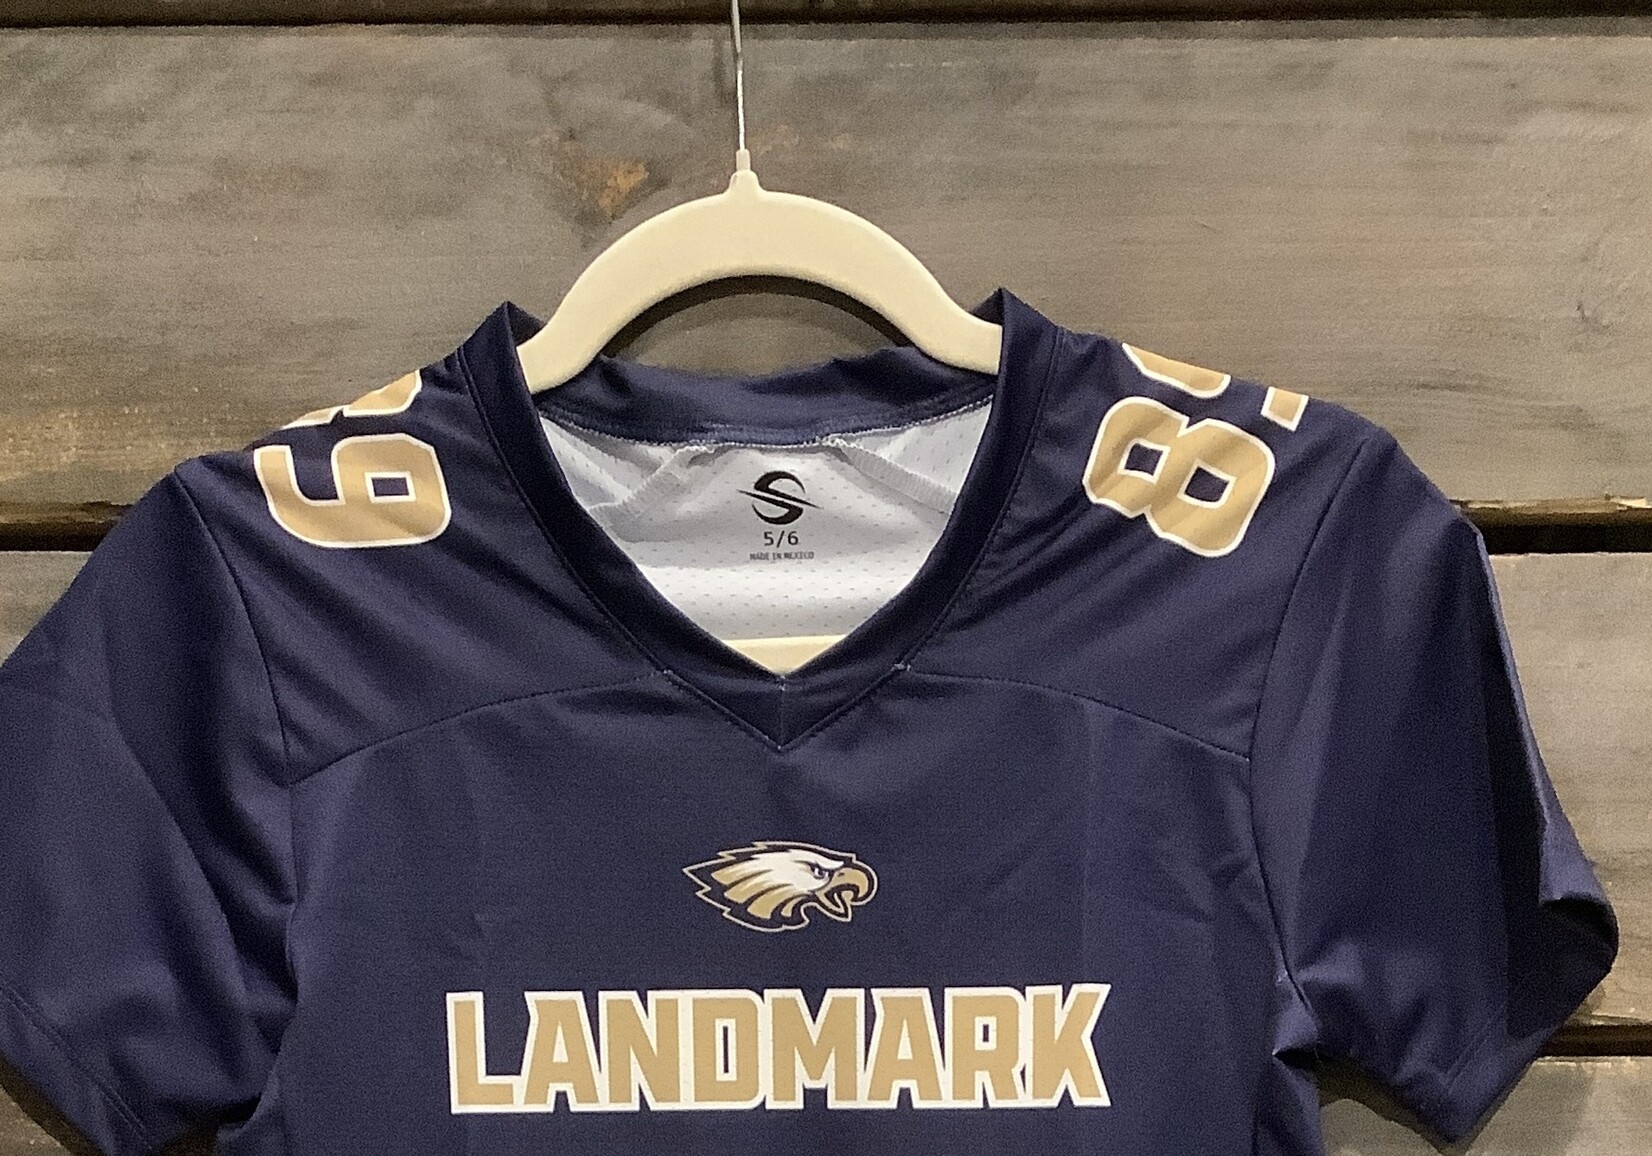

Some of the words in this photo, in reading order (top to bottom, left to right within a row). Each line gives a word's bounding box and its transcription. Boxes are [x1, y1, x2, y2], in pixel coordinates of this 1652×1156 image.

[253, 369, 451, 548] 9
[1082, 342, 1309, 557] 8
[749, 552, 769, 560] MADE
[772, 552, 782, 560] IN
[784, 551, 815, 560] MEXICO
[763, 530, 799, 548] 5/6
[446, 983, 1112, 1115] LANDMARK
